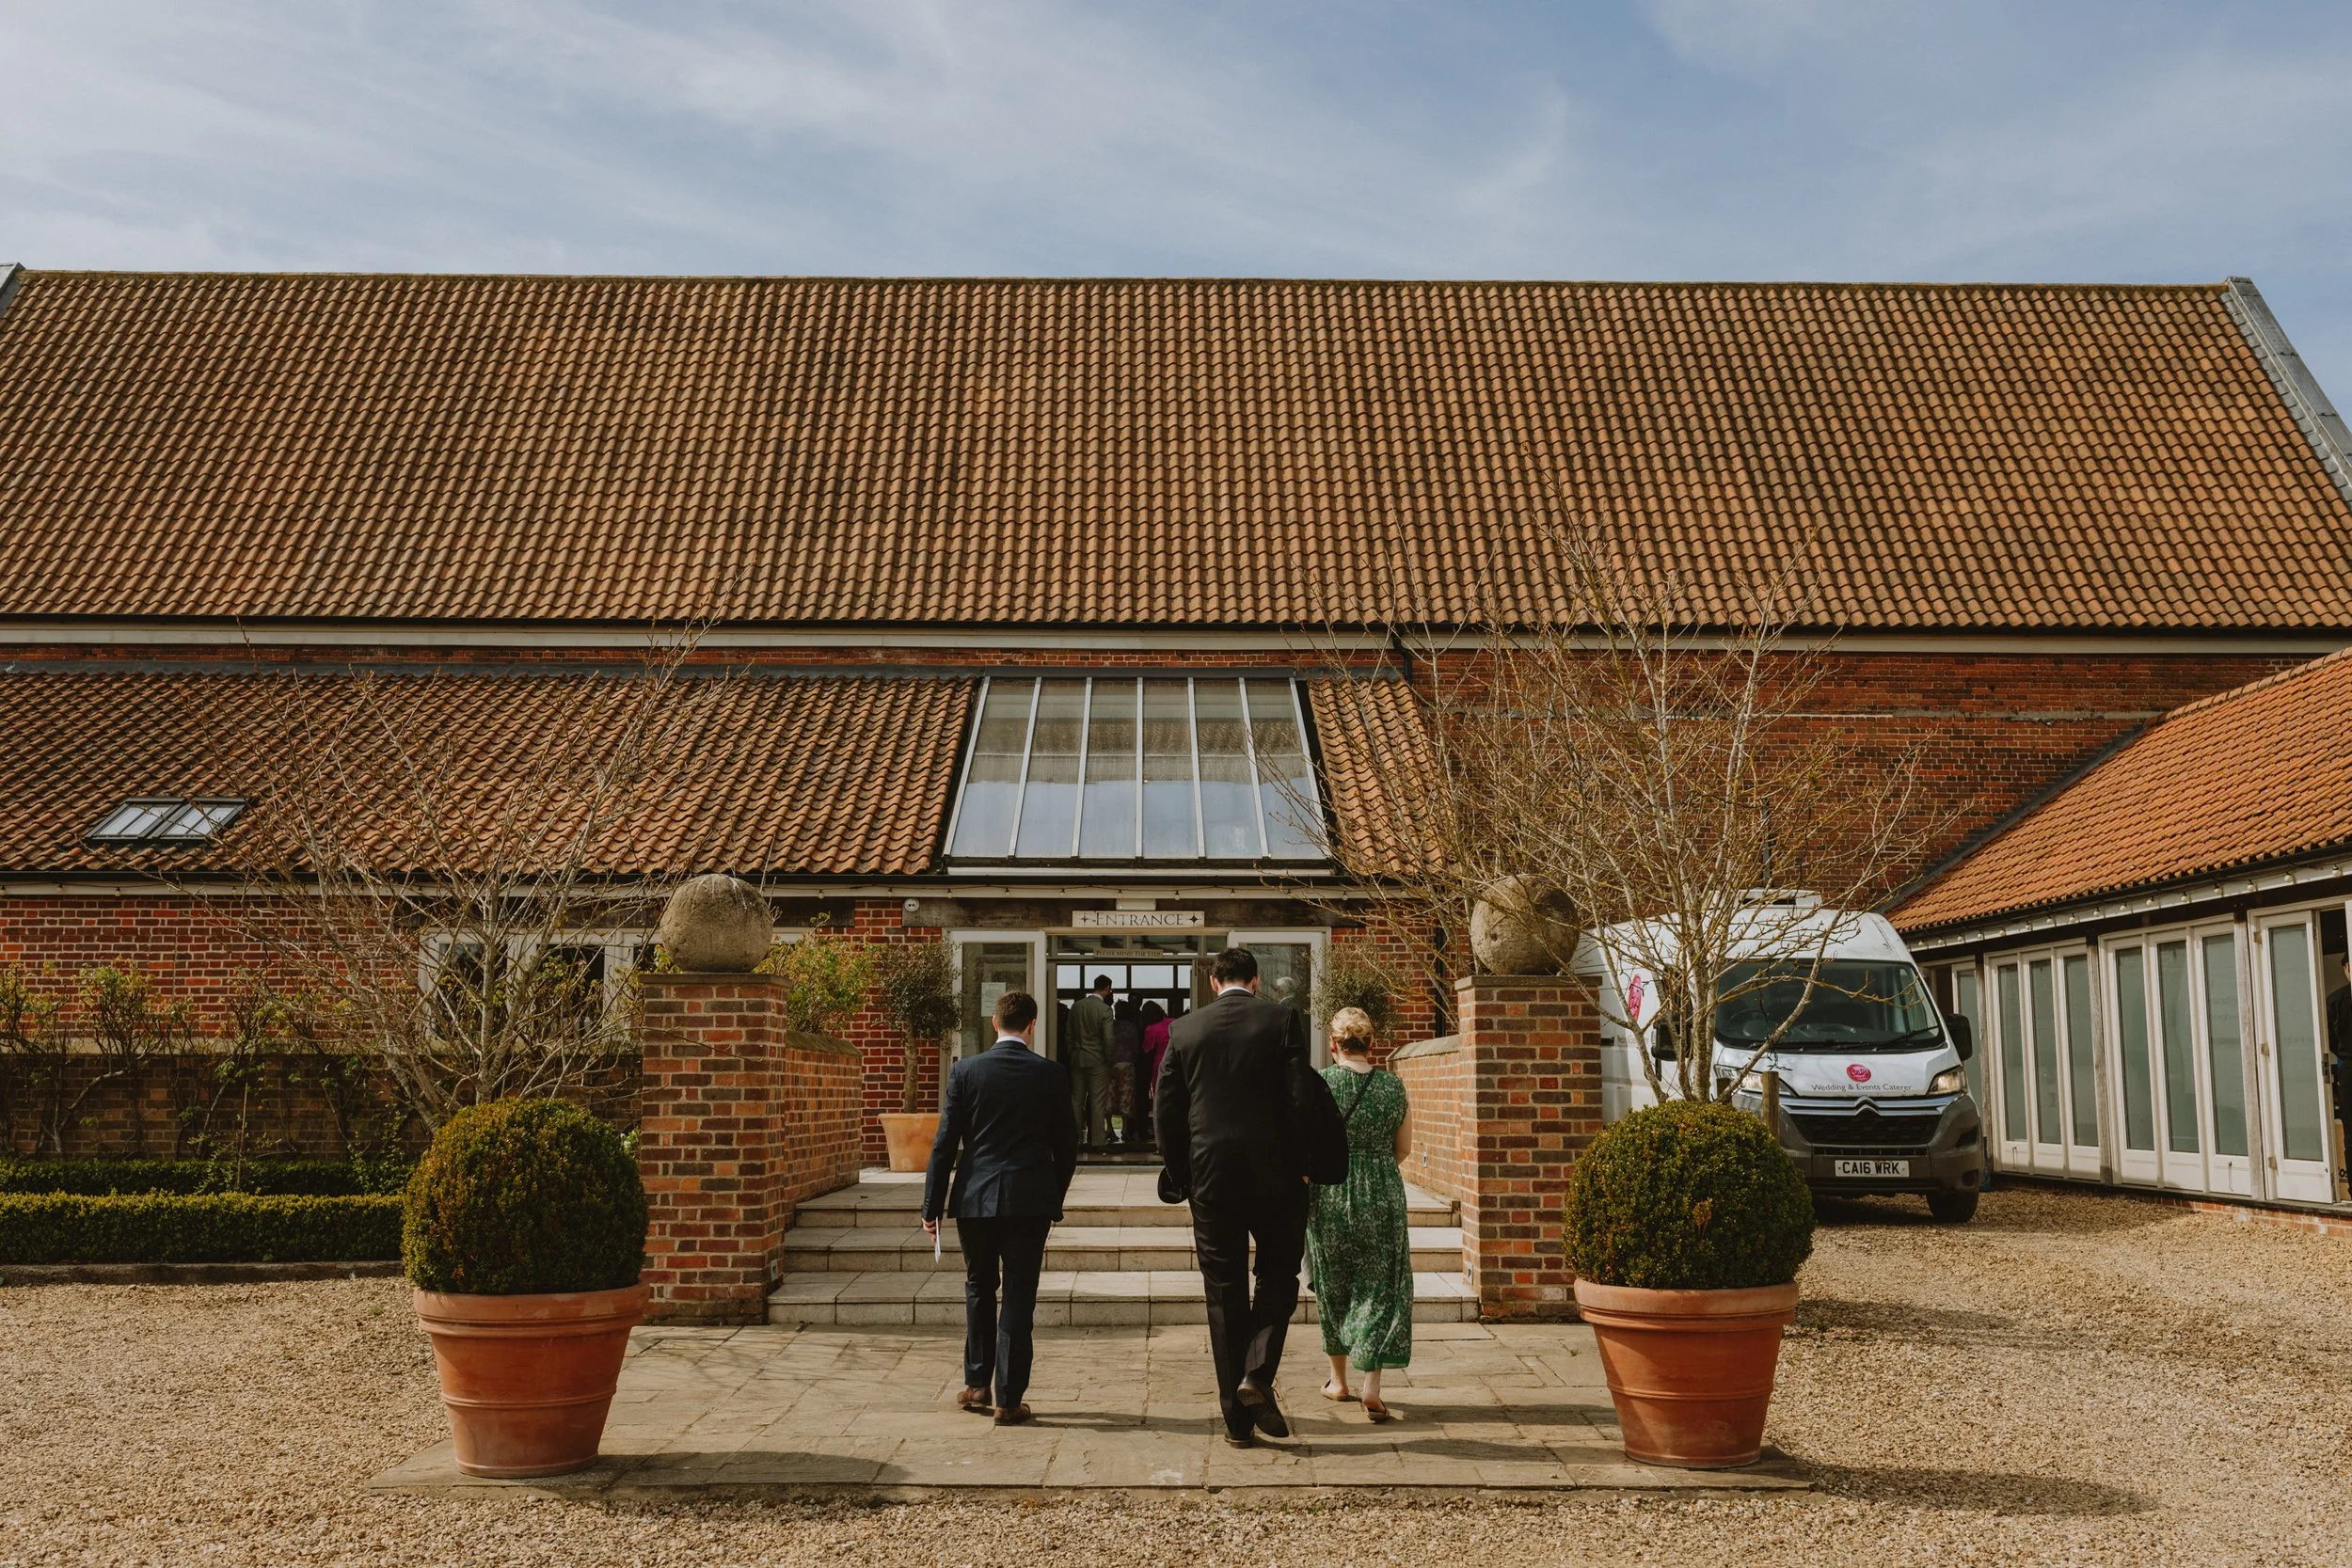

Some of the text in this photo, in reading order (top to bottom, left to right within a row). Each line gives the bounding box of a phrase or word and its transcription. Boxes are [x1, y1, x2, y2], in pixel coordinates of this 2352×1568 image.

[1096, 912, 1184, 926] ENTRANCE
[1842, 1162, 1900, 1174] CA16 WRK
